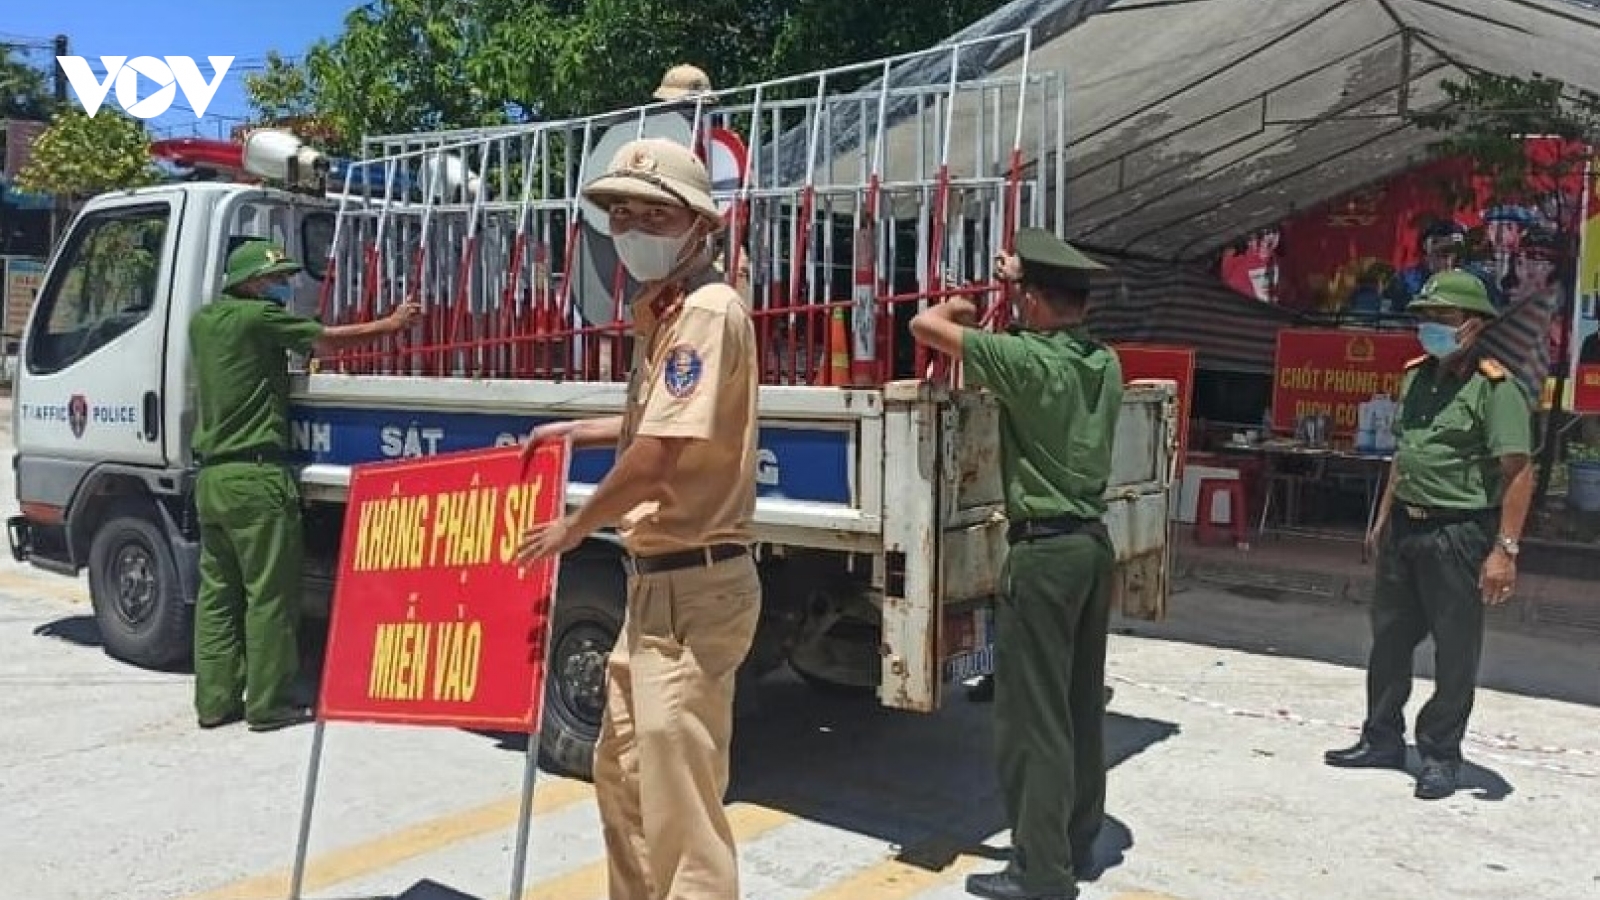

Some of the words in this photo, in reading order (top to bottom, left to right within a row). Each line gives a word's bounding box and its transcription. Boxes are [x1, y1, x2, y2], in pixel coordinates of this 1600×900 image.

[92, 406, 136, 422] POLICE
[353, 480, 430, 572] KHÔNG
[428, 472, 498, 585] PHẬN
[433, 603, 482, 702] VÀO
